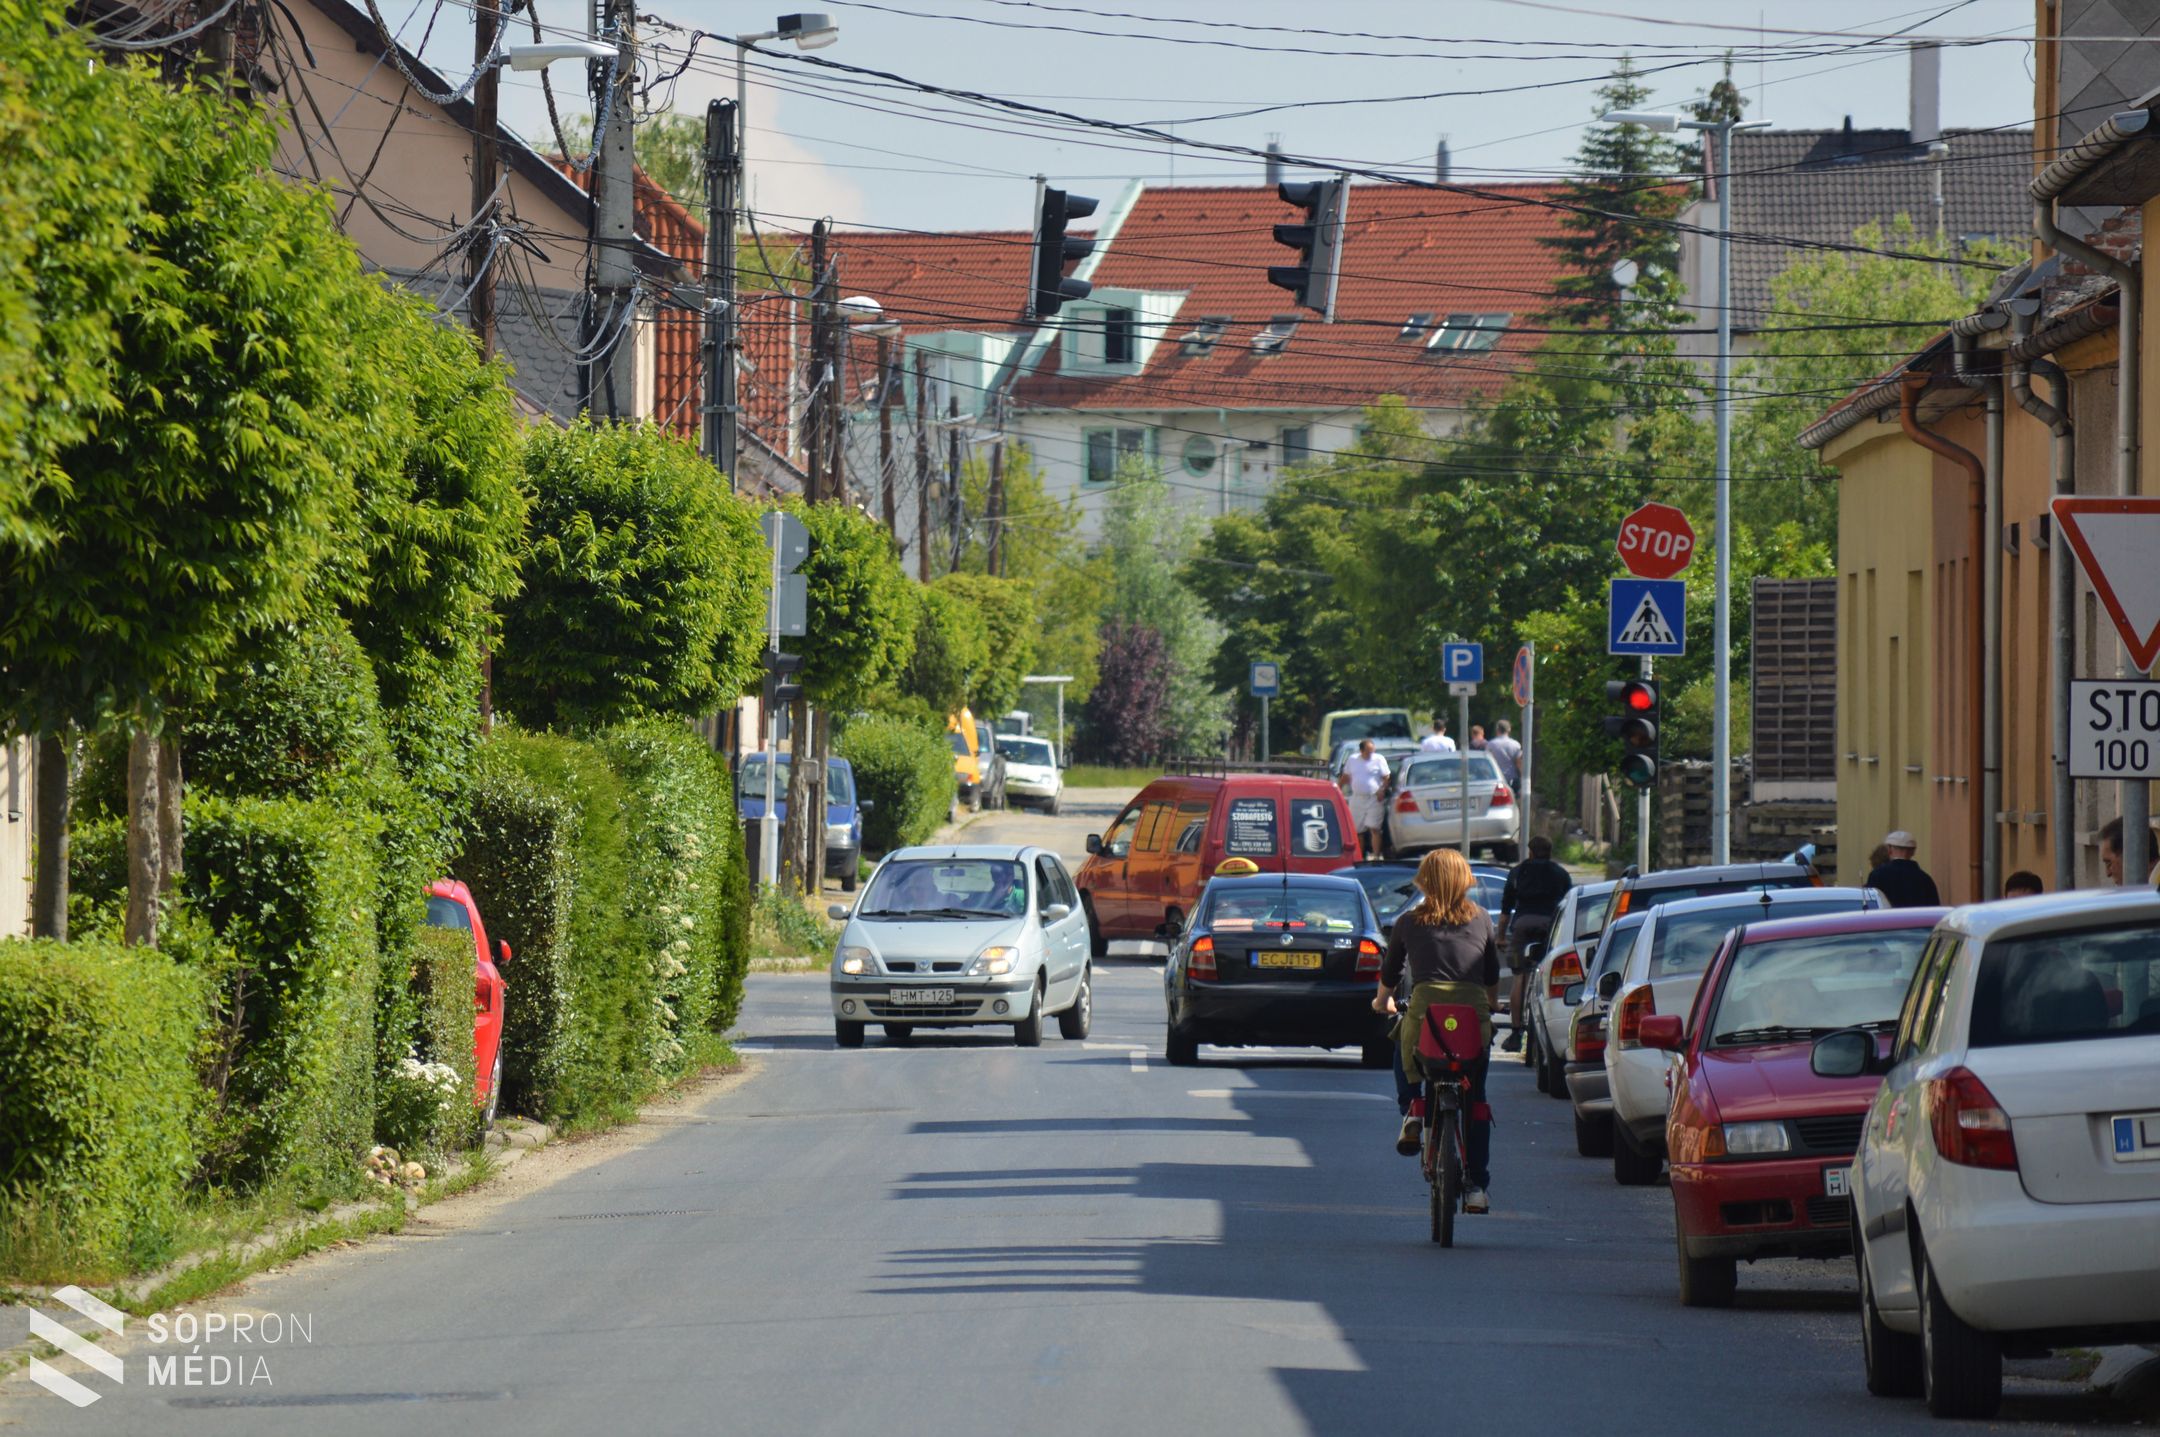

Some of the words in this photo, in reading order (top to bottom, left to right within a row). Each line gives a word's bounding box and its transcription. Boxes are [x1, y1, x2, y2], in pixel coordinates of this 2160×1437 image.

[1621, 523, 1691, 560] STOP
[1451, 648, 1474, 678] P
[2089, 688, 2160, 732] STO
[2094, 739, 2149, 771] 100
